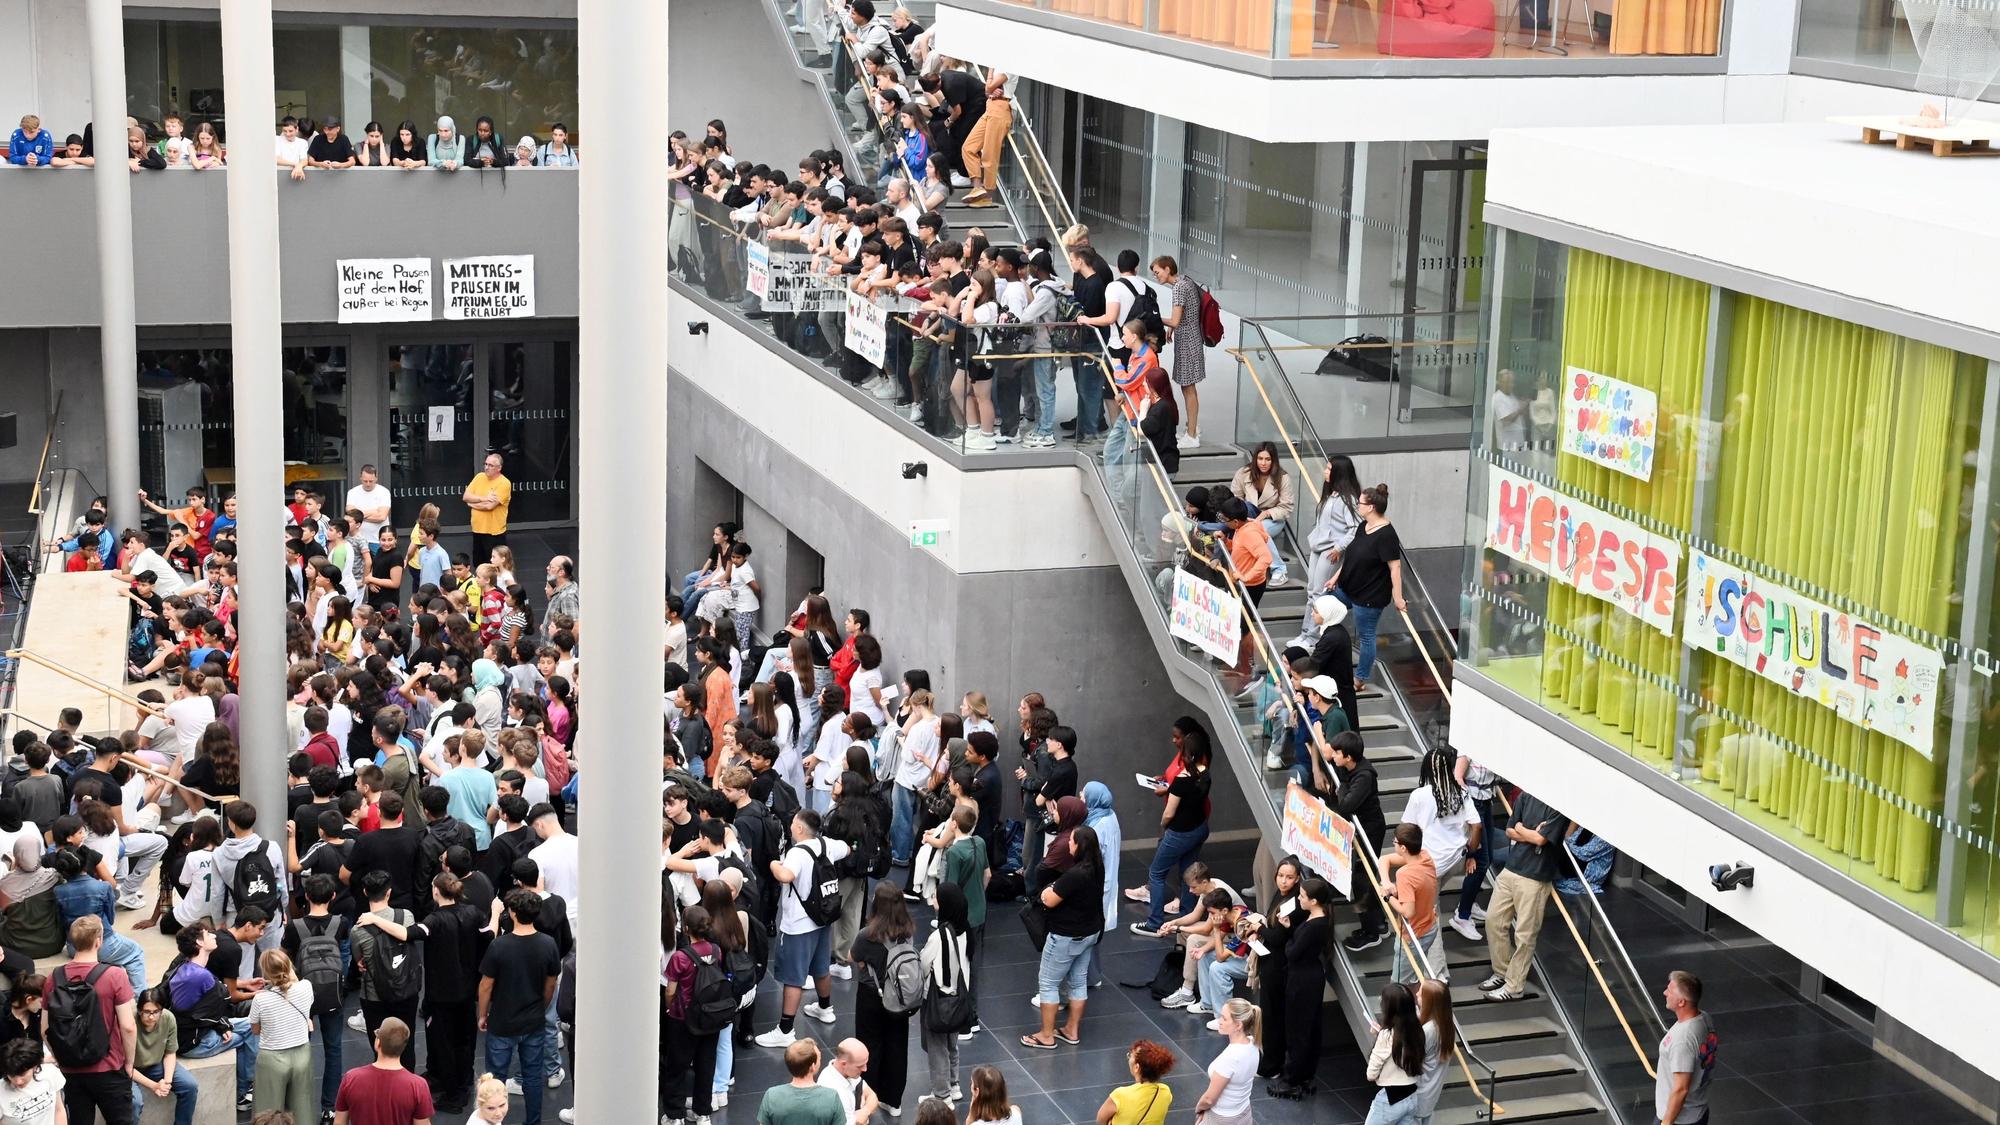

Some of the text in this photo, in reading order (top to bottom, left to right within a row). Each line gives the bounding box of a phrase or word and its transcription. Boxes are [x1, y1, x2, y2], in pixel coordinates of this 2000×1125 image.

[342, 264, 430, 281] Kleine Pausen
[450, 264, 523, 279] MITTAGS-
[344, 284, 365, 295] auf
[371, 280, 396, 294] dem
[451, 281, 520, 294] PAUSEN IM
[342, 296, 429, 312] außer bei Regen
[451, 296, 492, 308] ATRIUM
[511, 294, 528, 308] UG
[464, 308, 511, 317] ERLAUBT
[1713, 578, 1881, 691] SCHULE
